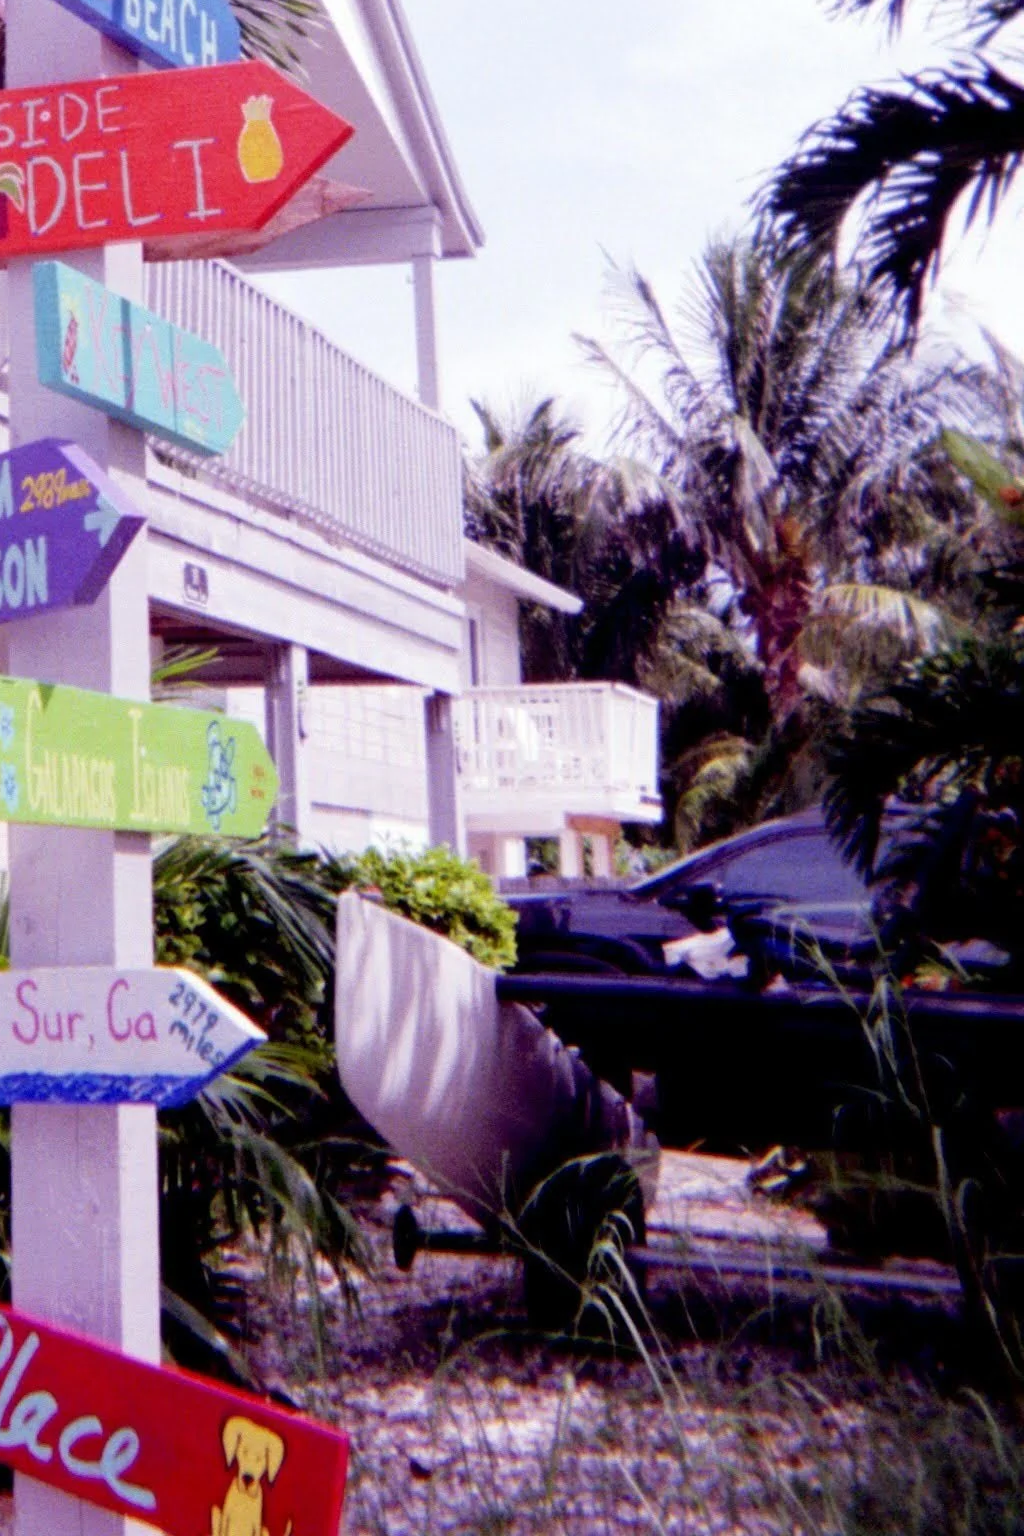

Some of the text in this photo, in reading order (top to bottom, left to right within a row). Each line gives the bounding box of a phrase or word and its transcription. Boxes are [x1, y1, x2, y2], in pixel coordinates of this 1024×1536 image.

[26, 136, 224, 236] DELI
[11, 978, 95, 1051] Sur,
[107, 977, 159, 1044] Ca
